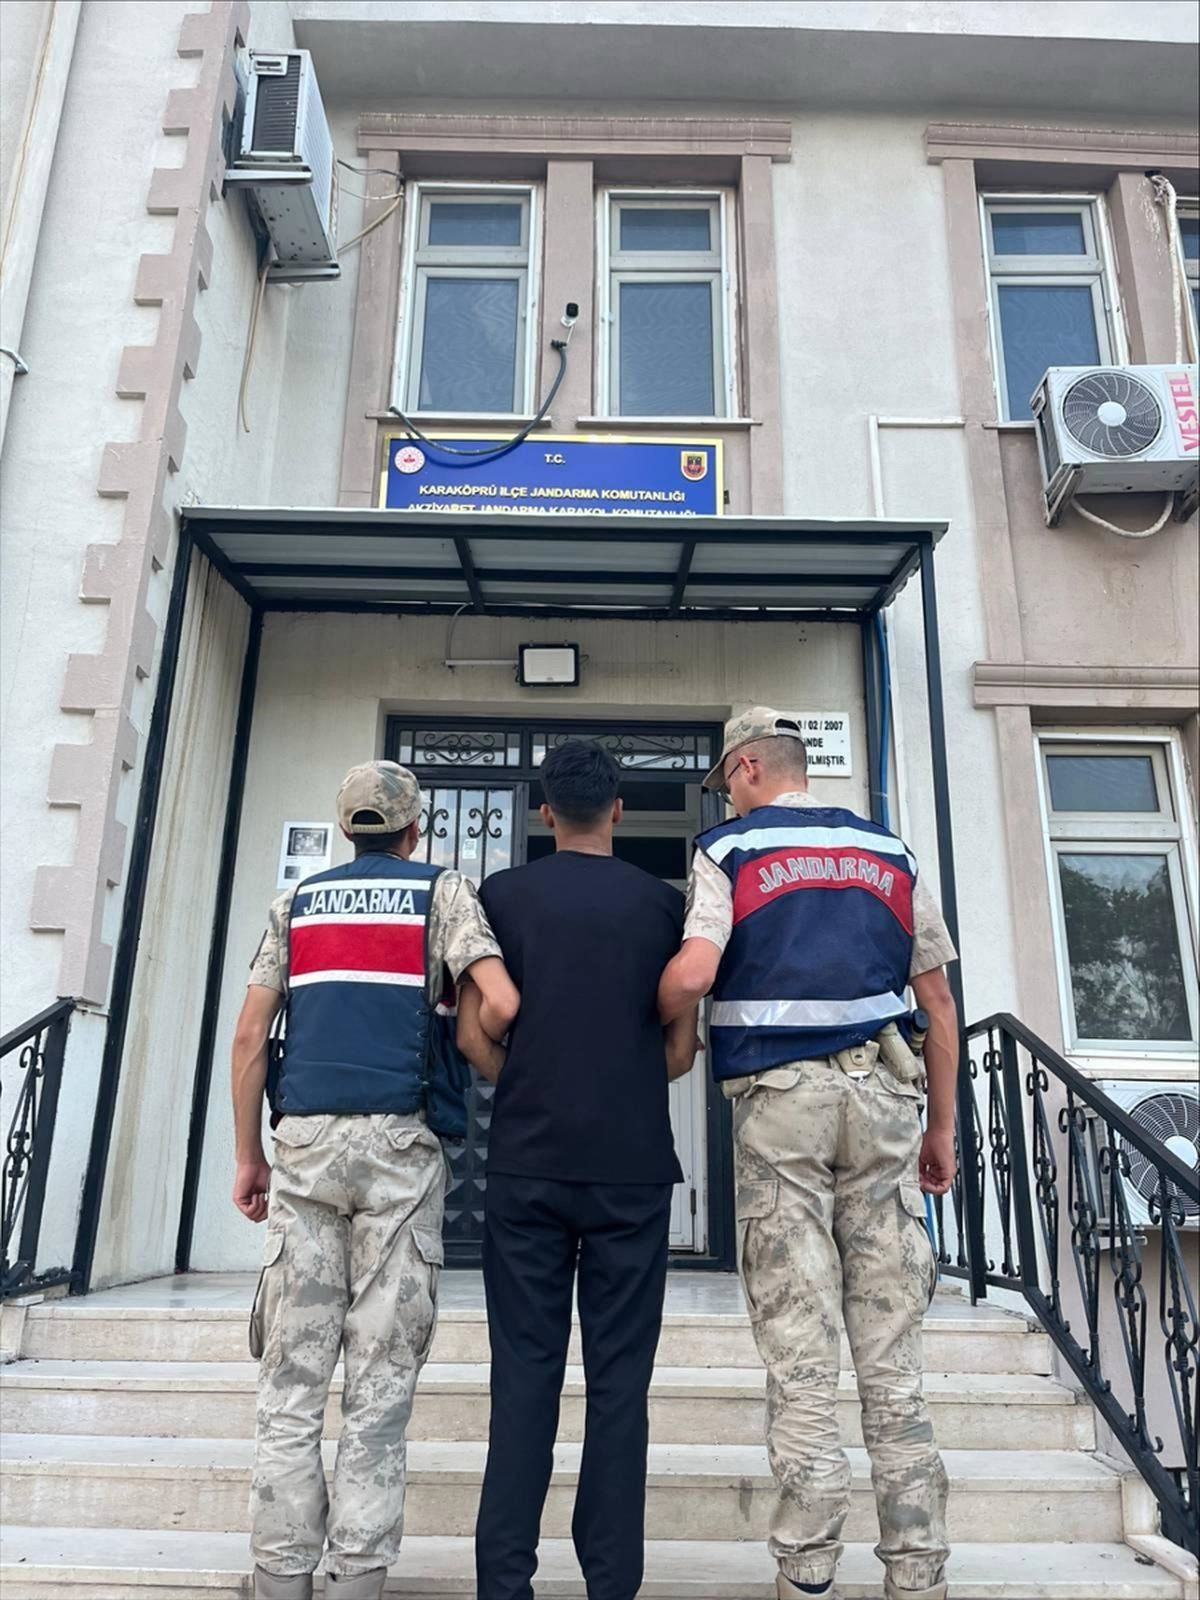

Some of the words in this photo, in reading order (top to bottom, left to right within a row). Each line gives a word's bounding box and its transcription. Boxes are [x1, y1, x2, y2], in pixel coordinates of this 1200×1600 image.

[1169, 373, 1199, 451] VESTEL
[544, 453, 566, 464] T.C.
[419, 484, 497, 496] KARAKÖPRÜ
[530, 487, 599, 499] JANDARMA
[601, 489, 686, 502] KOMUTANLIĞI
[824, 720, 843, 730] 2007
[759, 857, 894, 896] JANDARMA
[304, 889, 415, 915] JANDARMA
